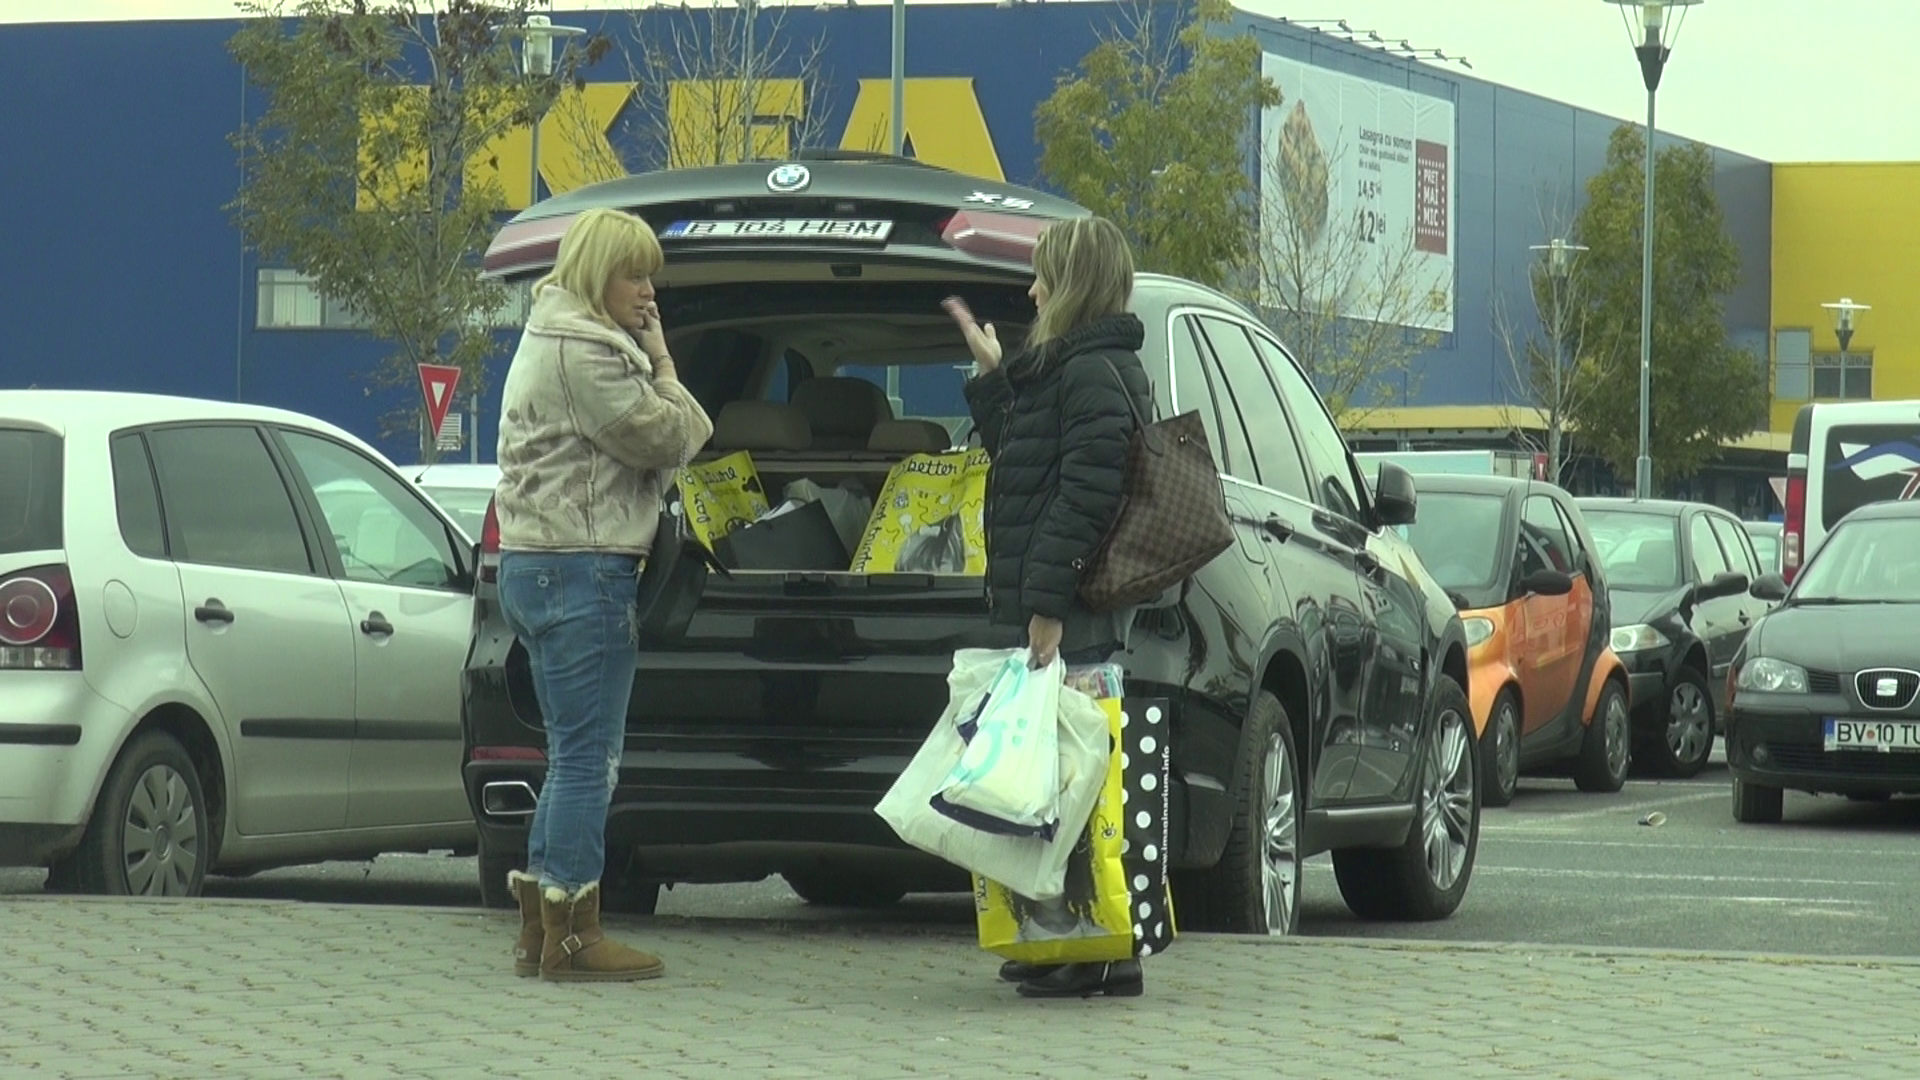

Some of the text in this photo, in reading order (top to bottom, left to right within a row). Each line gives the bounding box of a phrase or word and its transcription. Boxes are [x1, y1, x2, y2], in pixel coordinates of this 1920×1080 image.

[355, 77, 1007, 213] IKEA
[1423, 185, 1439, 206] MAI
[1358, 207, 1386, 244] 12 lei
[1423, 206, 1439, 227] MIC
[734, 220, 786, 235] 104
[906, 458, 957, 476] better
[1837, 722, 1867, 743] BV
[1875, 723, 1895, 744] 10
